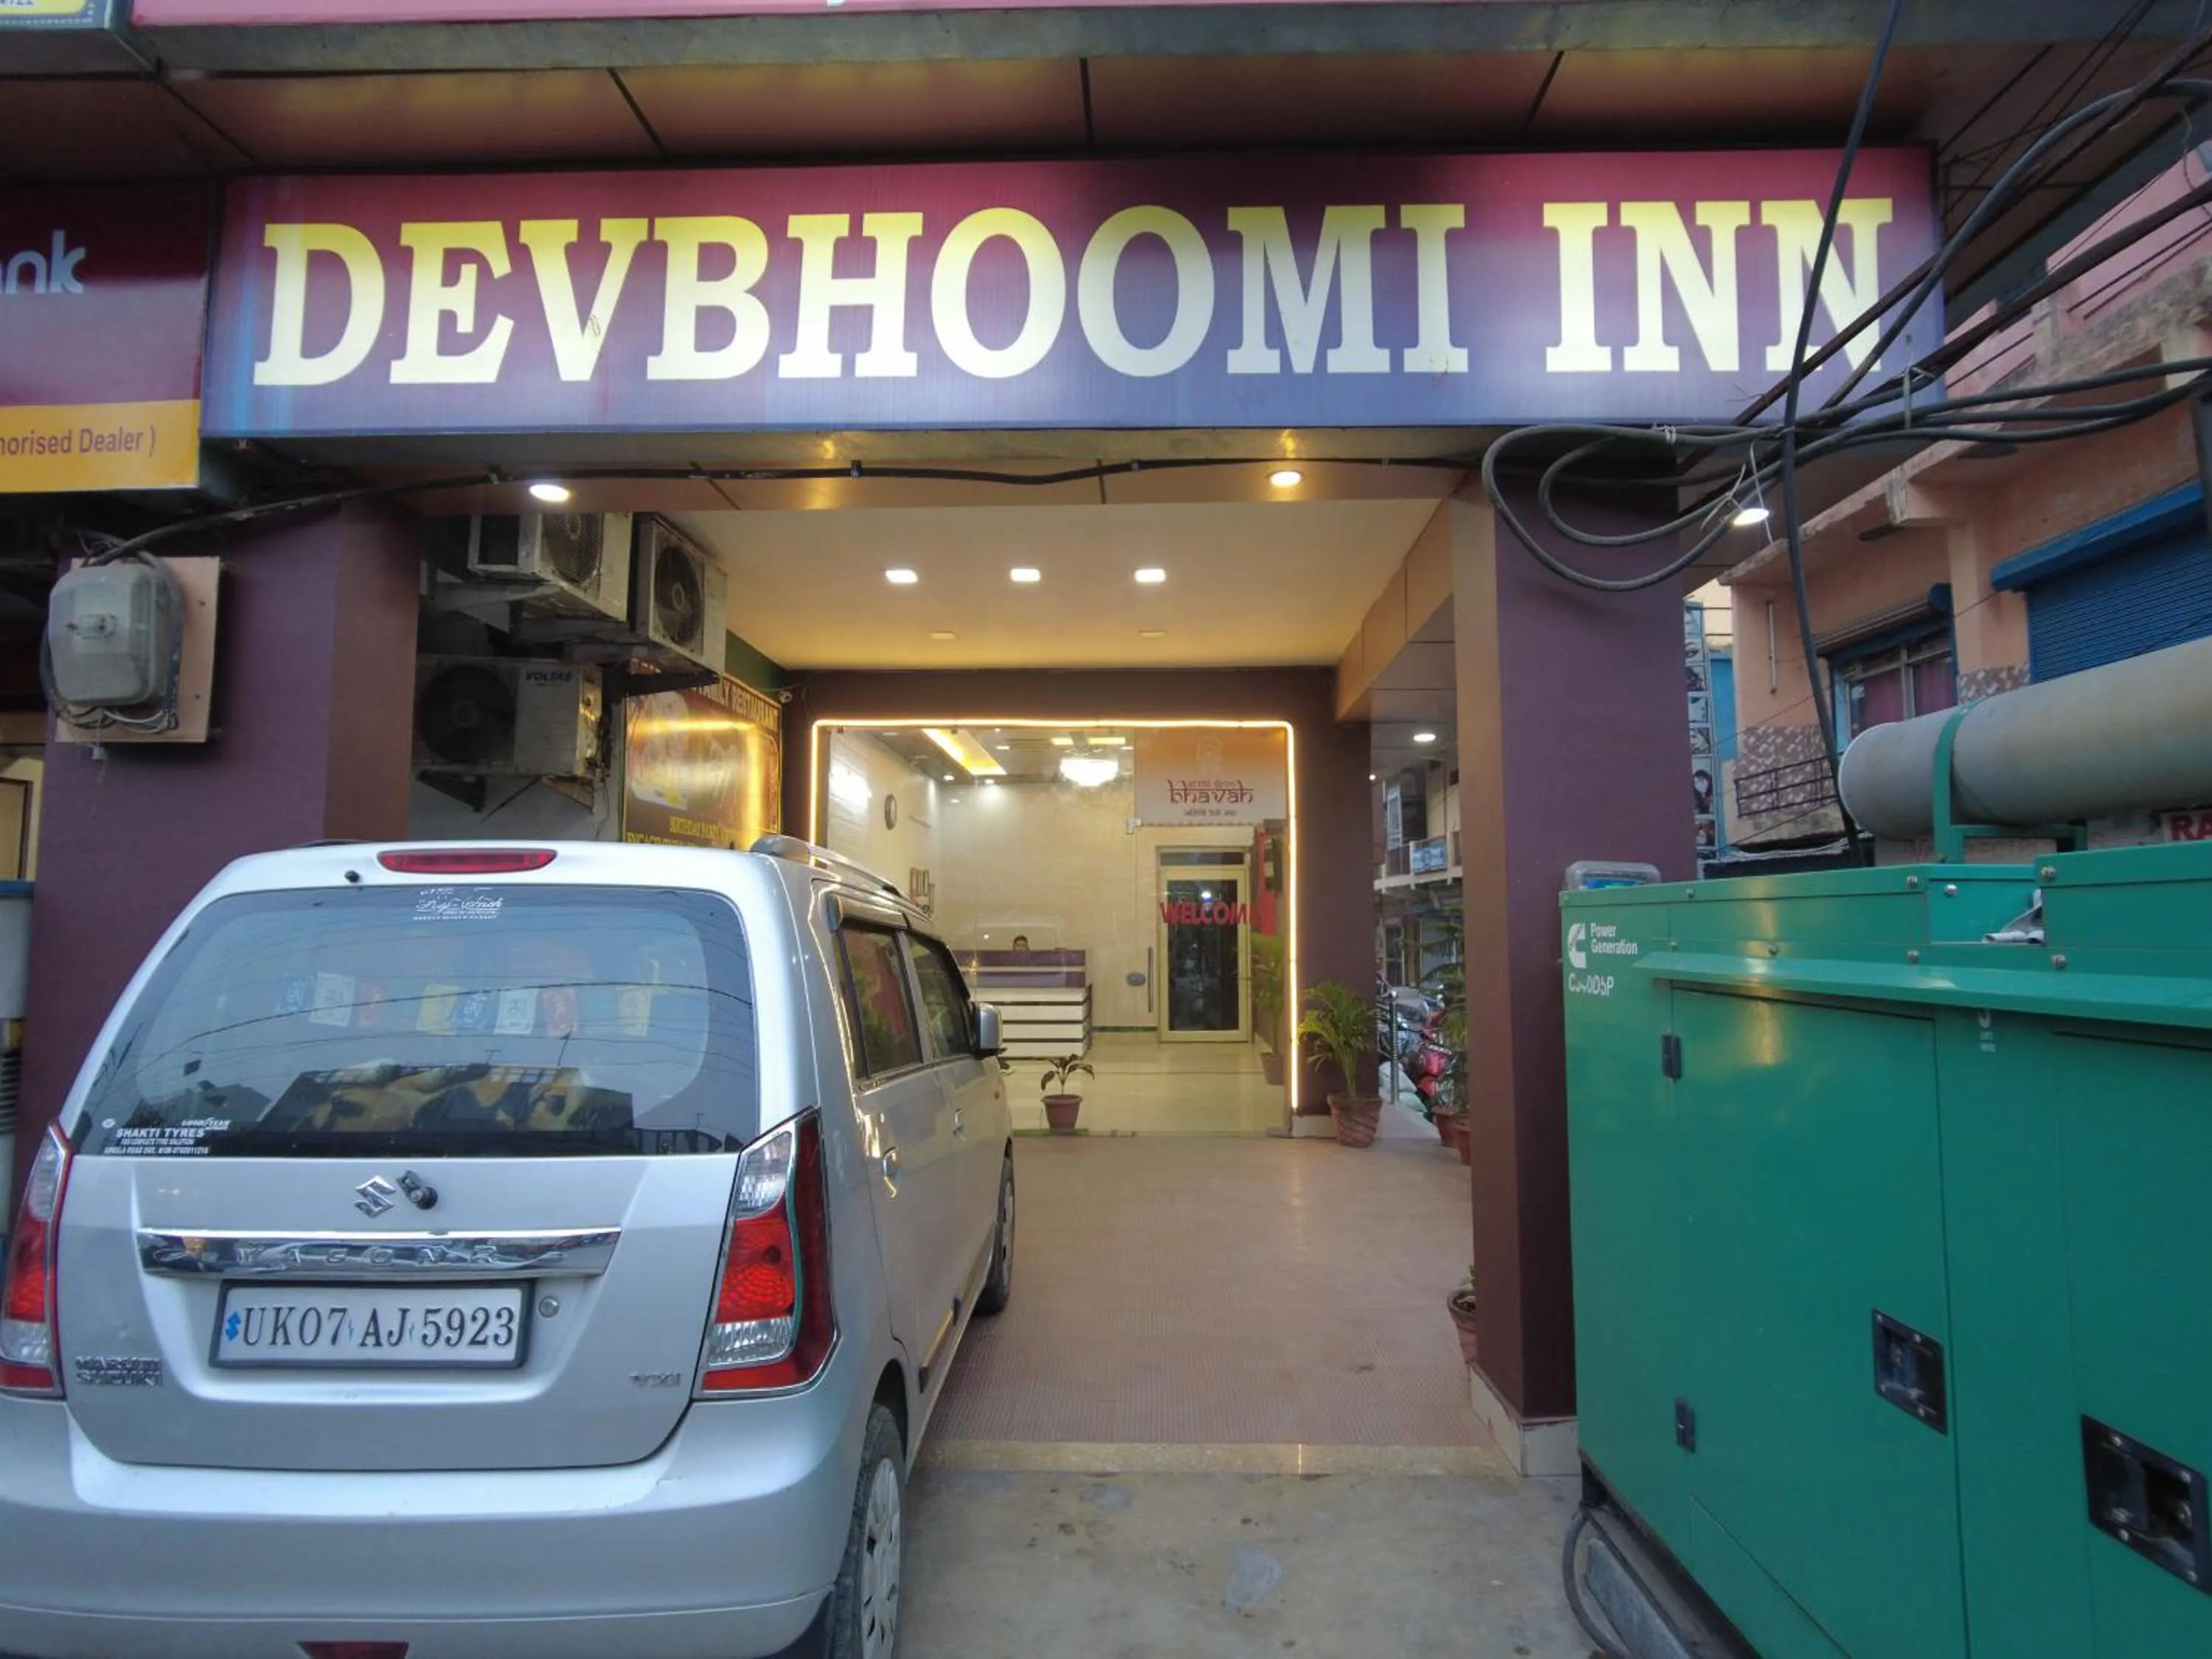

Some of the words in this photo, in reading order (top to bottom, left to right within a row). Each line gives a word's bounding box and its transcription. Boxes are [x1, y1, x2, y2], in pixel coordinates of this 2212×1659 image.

[0, 230, 86, 293] nk
[254, 204, 1469, 386] DEVBHOOMI
[1543, 198, 1893, 372] INN
[79, 425, 144, 453] Dealer
[1590, 922, 1616, 937] Power
[1591, 939, 1638, 955] Generation
[116, 1127, 160, 1138] SHAKTI
[164, 1127, 205, 1138] TYRES
[243, 1307, 348, 1346] UK07
[358, 1307, 411, 1347] AJ
[421, 1306, 515, 1347] 5923
